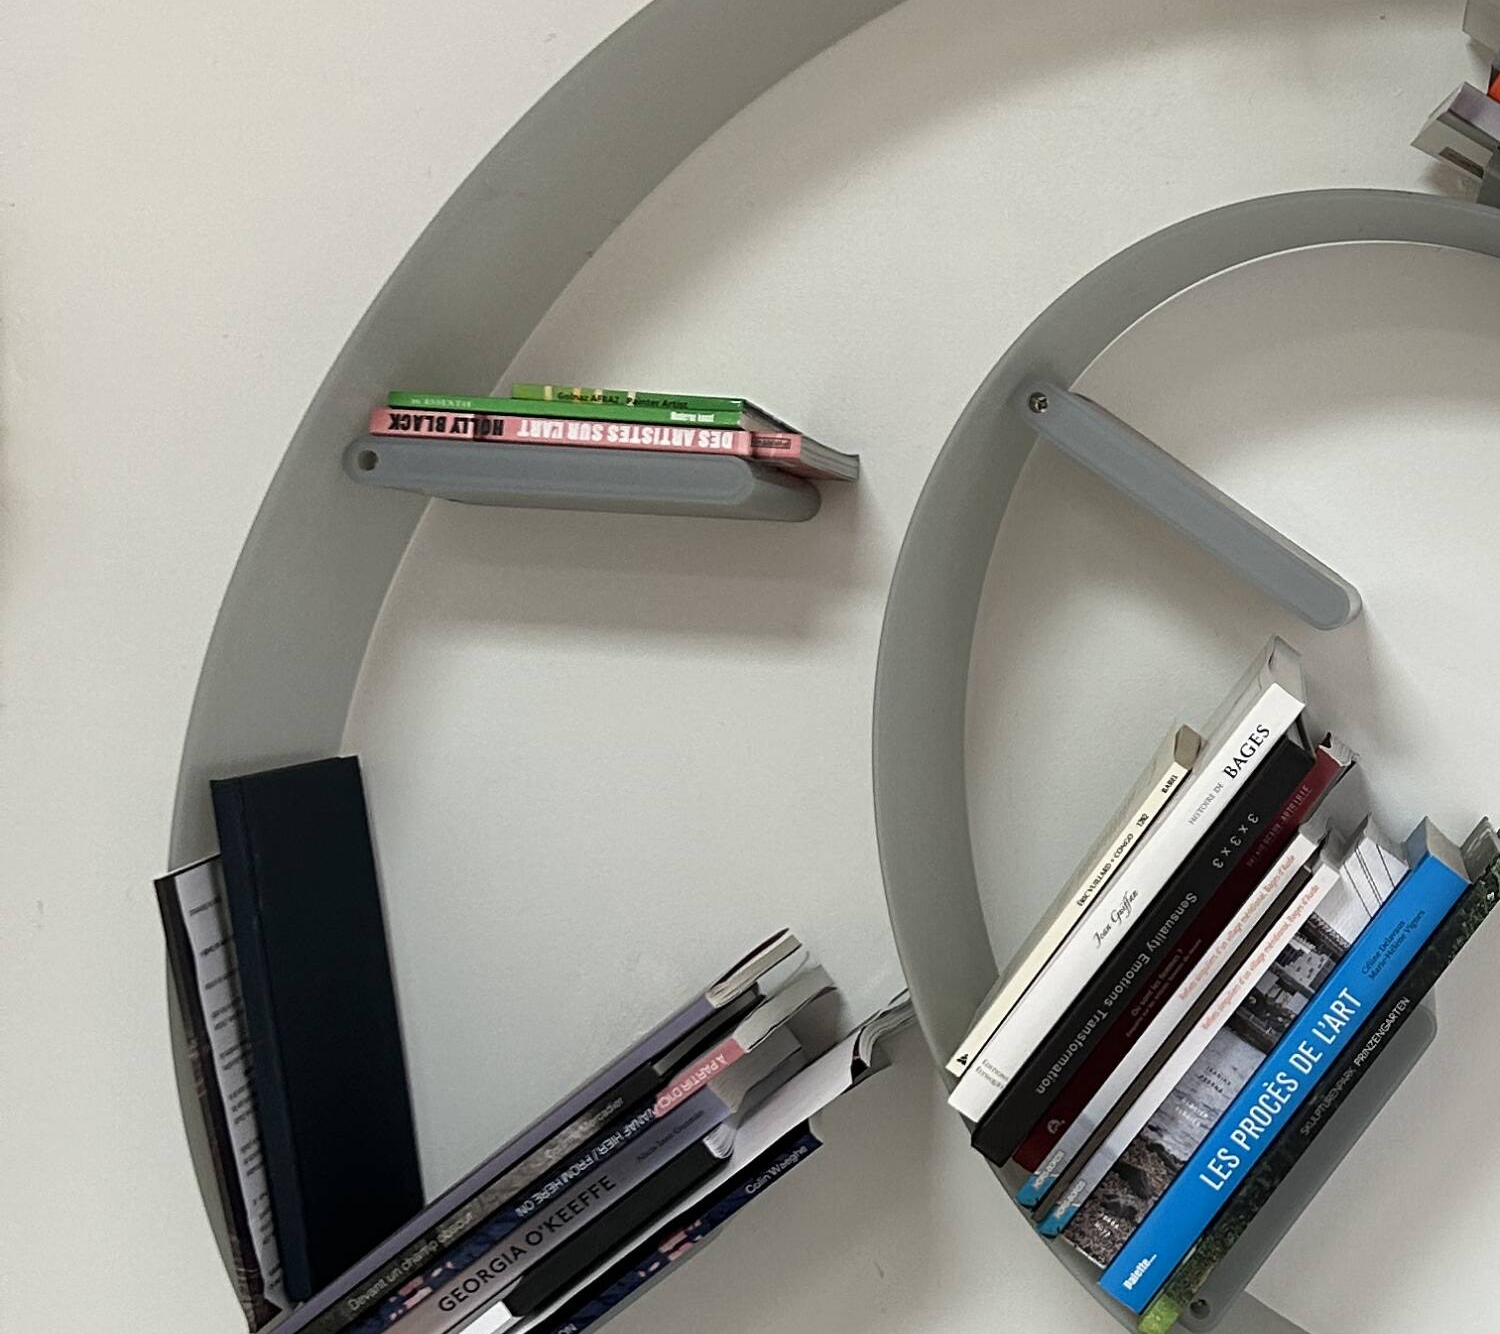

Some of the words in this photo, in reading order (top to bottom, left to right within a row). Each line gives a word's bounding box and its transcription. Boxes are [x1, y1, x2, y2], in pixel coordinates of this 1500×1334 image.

[386, 411, 447, 434] BLACK
[450, 415, 504, 437] HOLLY
[515, 417, 563, 440] L'ART
[565, 419, 603, 442] SUR
[606, 420, 695, 448] ARTISTES
[696, 427, 734, 450] DES
[1219, 721, 1274, 781] BAGES
[1244, 810, 1260, 825] 3
[1226, 833, 1243, 848] 3
[1208, 855, 1225, 872] 3
[1142, 887, 1200, 956] Sensuality
[1357, 947, 1384, 975] Céline
[1100, 949, 1152, 1011] Emotions
[1351, 994, 1413, 1068] PRINZENGARTEN
[1033, 1004, 1110, 1098] Transformation
[683, 1057, 720, 1089] PARTIR
[1197, 1144, 1243, 1192] LES
[1223, 1065, 1301, 1151] PROCÈS
[1287, 1038, 1324, 1076] DE
[1310, 986, 1365, 1046] L'ART
[593, 1129, 624, 1157] HIER
[557, 1152, 595, 1184] FROM
[529, 1176, 563, 1205] HERE
[743, 1169, 773, 1196] Colin
[513, 1197, 536, 1219] ON
[434, 1237, 529, 1317] GEORGIA
[520, 1170, 617, 1251] O'KEEFFE
